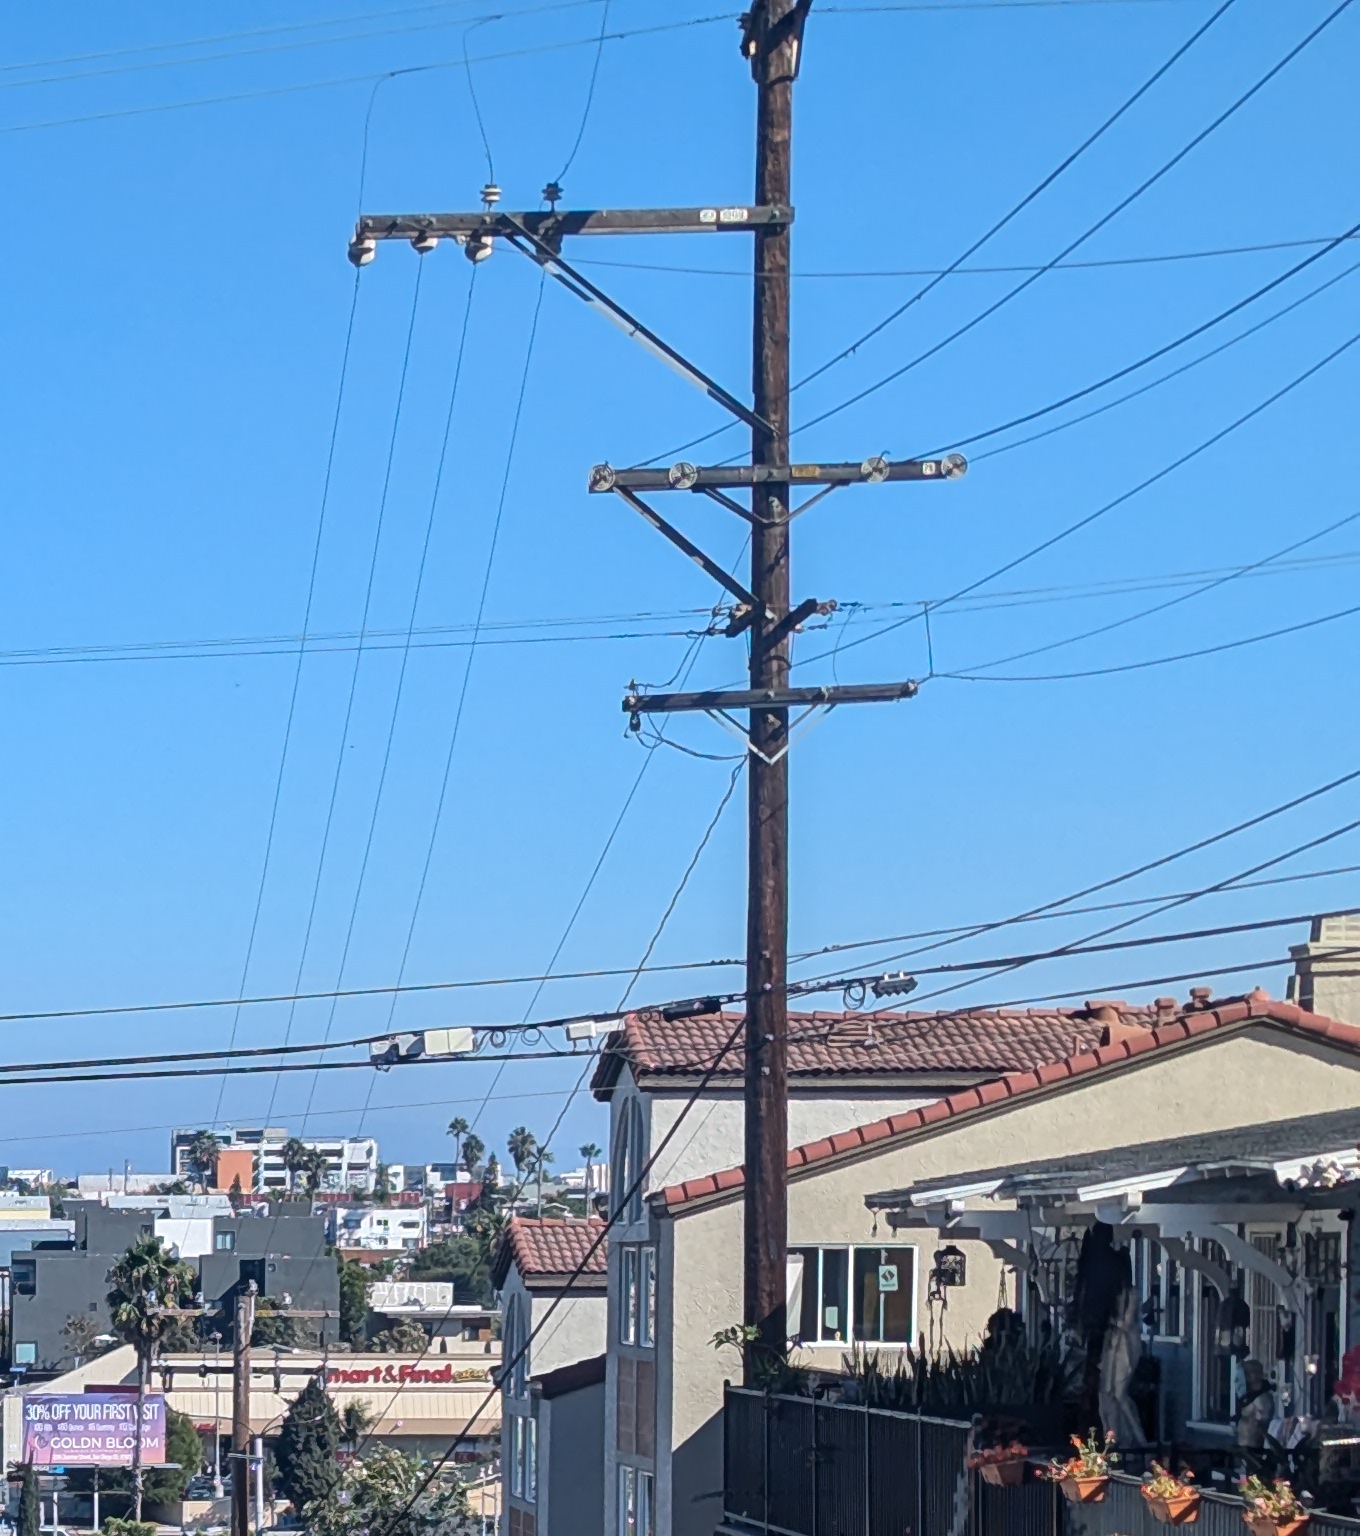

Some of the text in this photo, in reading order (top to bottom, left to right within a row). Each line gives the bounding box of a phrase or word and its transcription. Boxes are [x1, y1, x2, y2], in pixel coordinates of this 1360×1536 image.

[25, 1404, 160, 1420] 30% OFF YOUR FIRST VSIT
[50, 1437, 101, 1449] GOLDN
